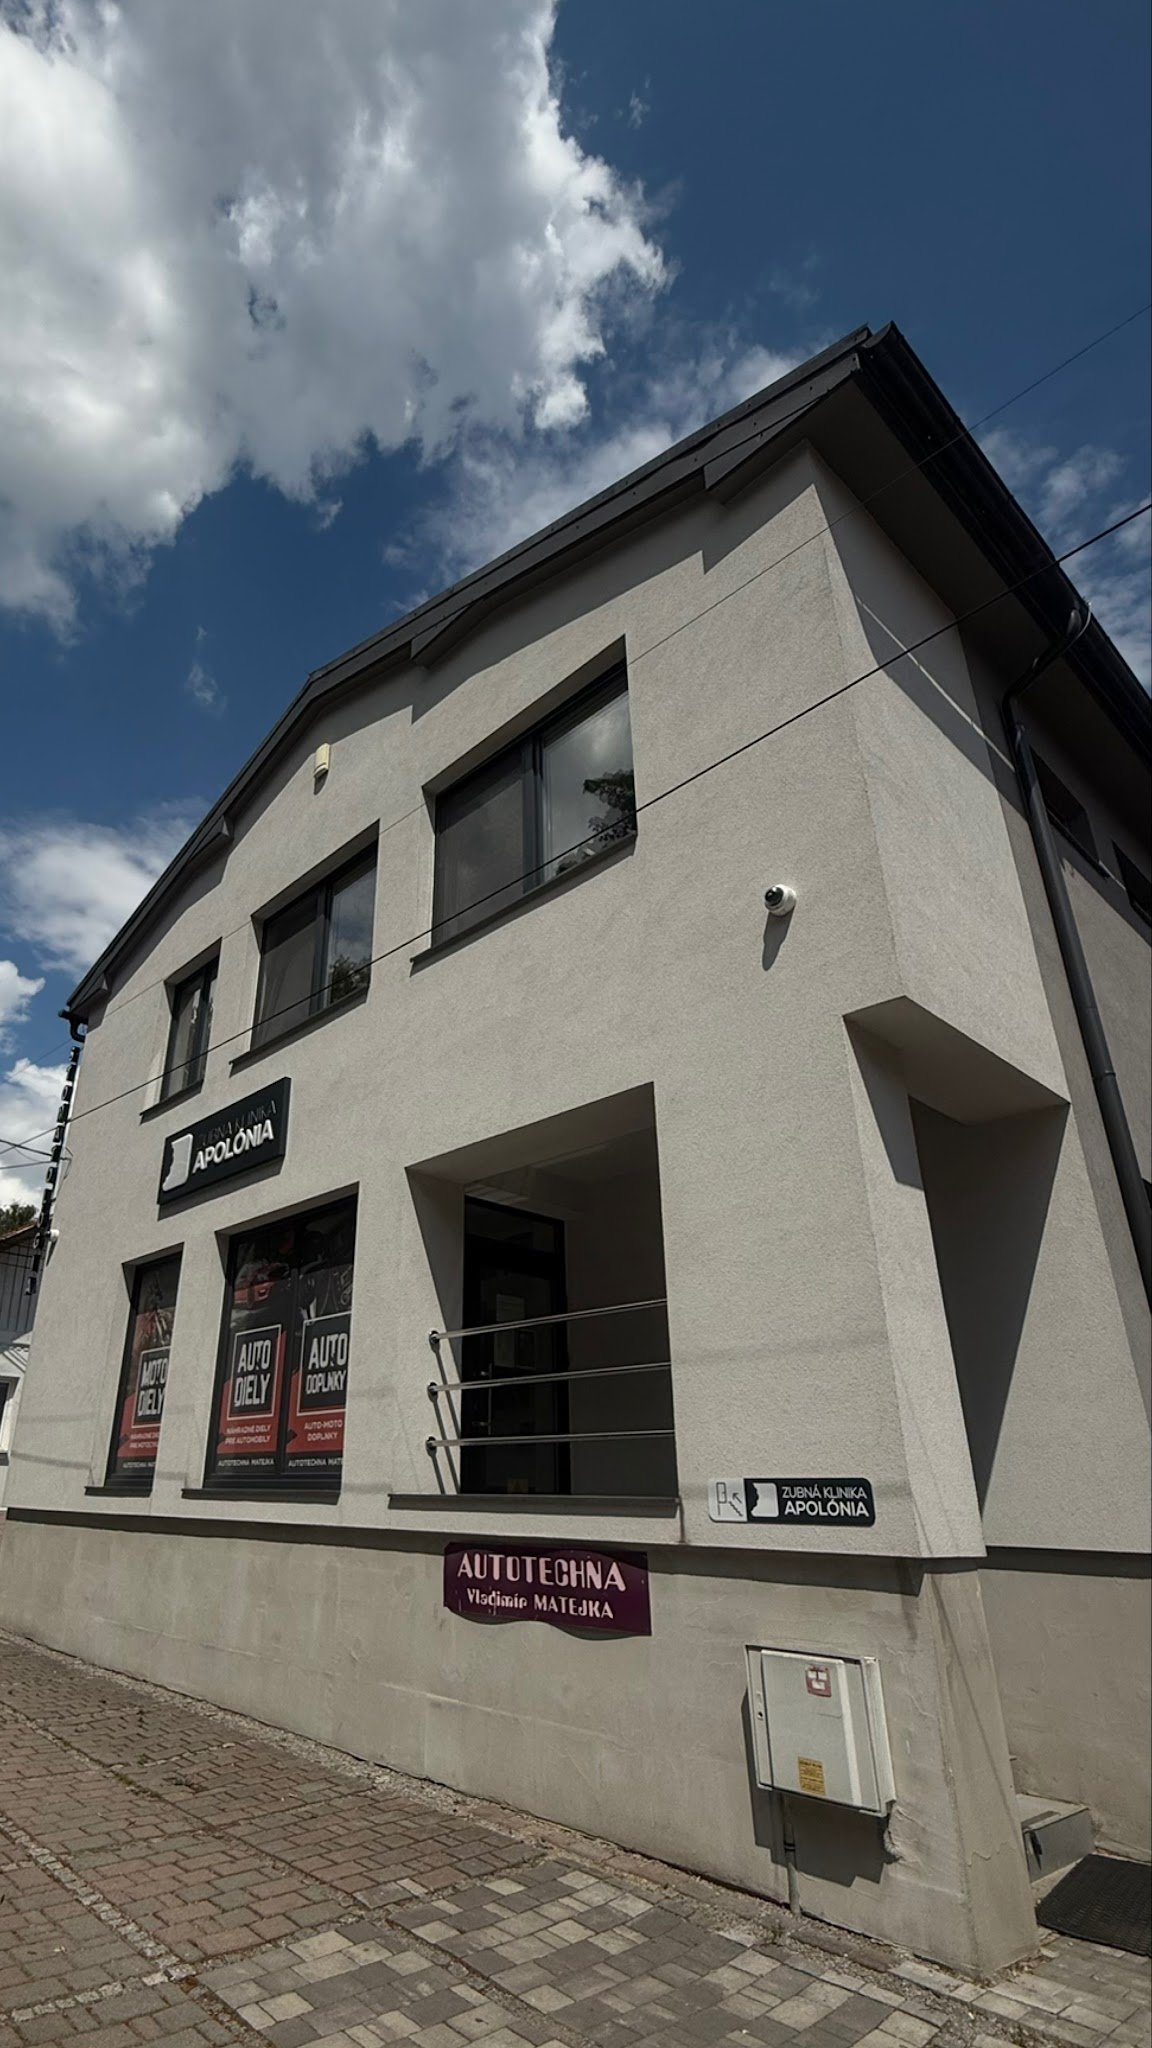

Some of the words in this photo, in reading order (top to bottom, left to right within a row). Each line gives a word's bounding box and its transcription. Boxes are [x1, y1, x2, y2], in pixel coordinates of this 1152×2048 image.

[192, 1119, 274, 1174] APOLÓNIA
[237, 1339, 271, 1373] AUTO
[308, 1333, 348, 1370] AUTO
[141, 1358, 169, 1387] MOTO
[306, 1369, 347, 1395] DOPLNKY
[234, 1373, 271, 1408] DIELY
[304, 1419, 343, 1430] AUTO-MOTO
[782, 1484, 822, 1499] ZUBNÁ
[823, 1486, 867, 1499] KLINIKA
[784, 1499, 870, 1517] APOLÓNIA
[457, 1552, 627, 1592] AUTOTECHNA
[534, 1593, 614, 1619] MATEJKA
